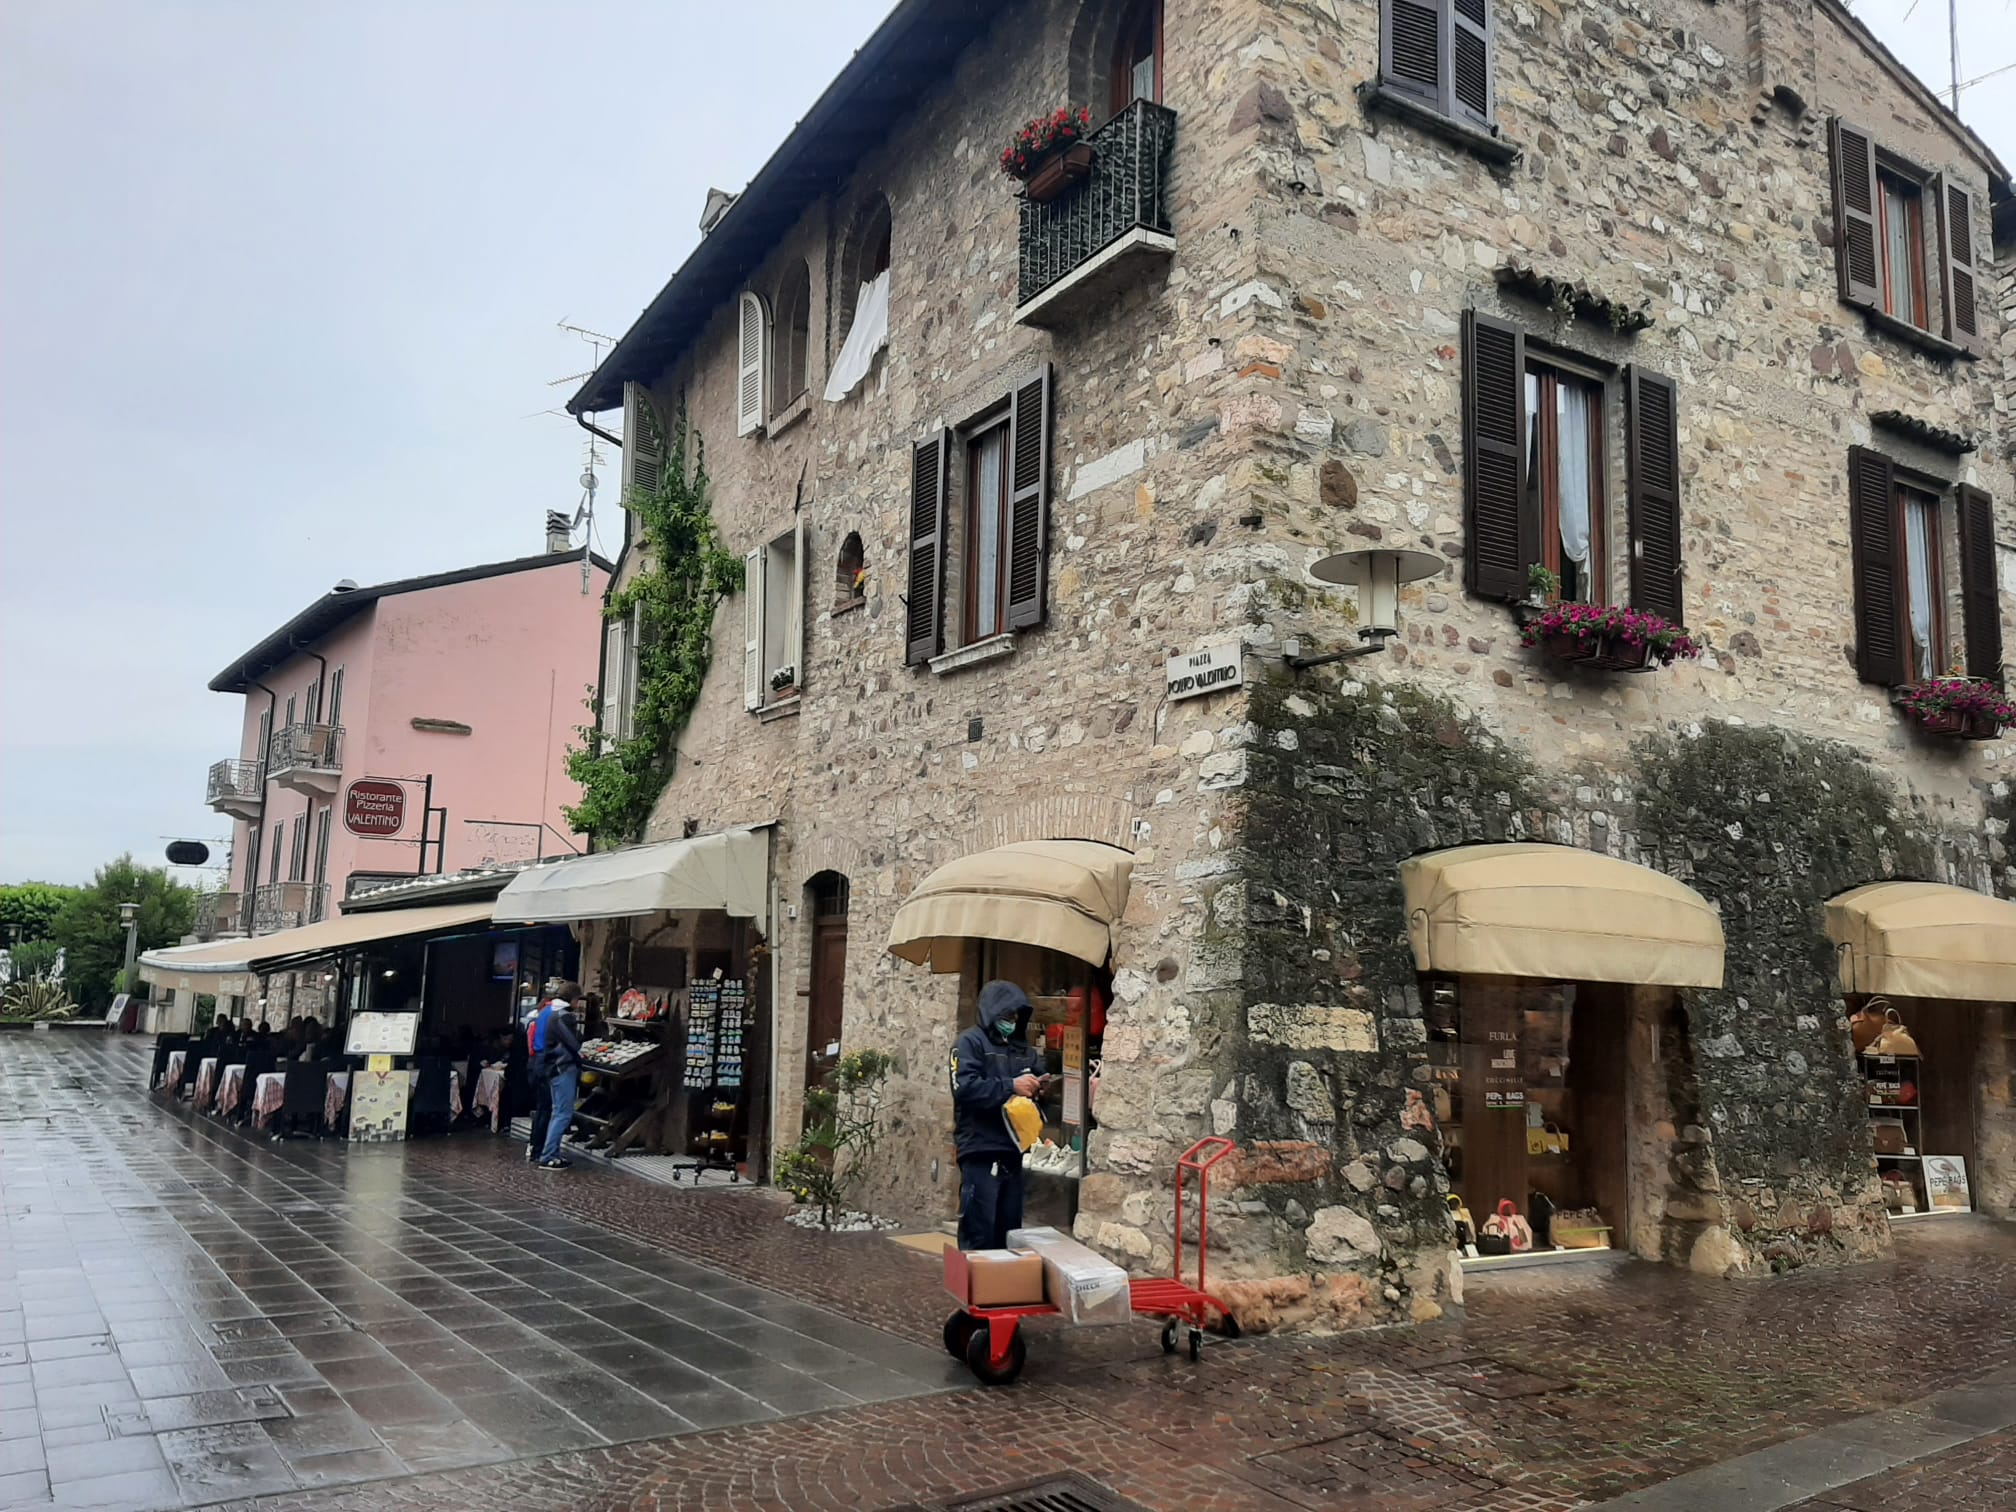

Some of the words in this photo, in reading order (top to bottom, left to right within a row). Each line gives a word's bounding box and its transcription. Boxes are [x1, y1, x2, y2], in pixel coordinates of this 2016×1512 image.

[1189, 653, 1211, 668] PIAZZA
[1195, 665, 1237, 688] VALENTINO
[350, 790, 402, 803] Ristorante
[356, 800, 395, 811] Pizzeria
[348, 812, 400, 827] VALENTINO
[1488, 1031, 1517, 1041] FURLA
